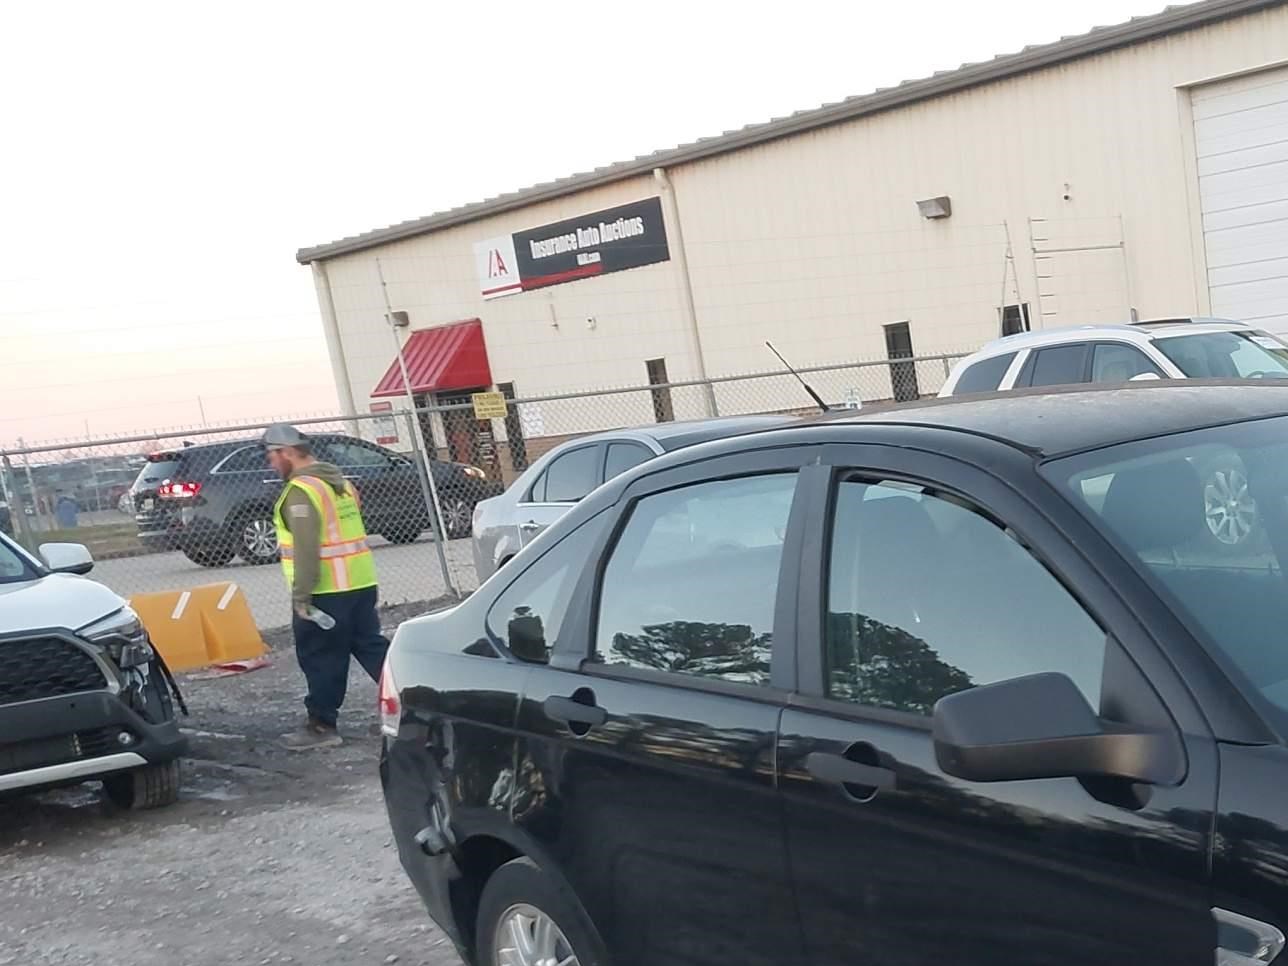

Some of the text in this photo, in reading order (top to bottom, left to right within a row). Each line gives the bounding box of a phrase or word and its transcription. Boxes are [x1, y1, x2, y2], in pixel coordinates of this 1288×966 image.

[529, 216, 644, 259] Insurance Auto Auctions
